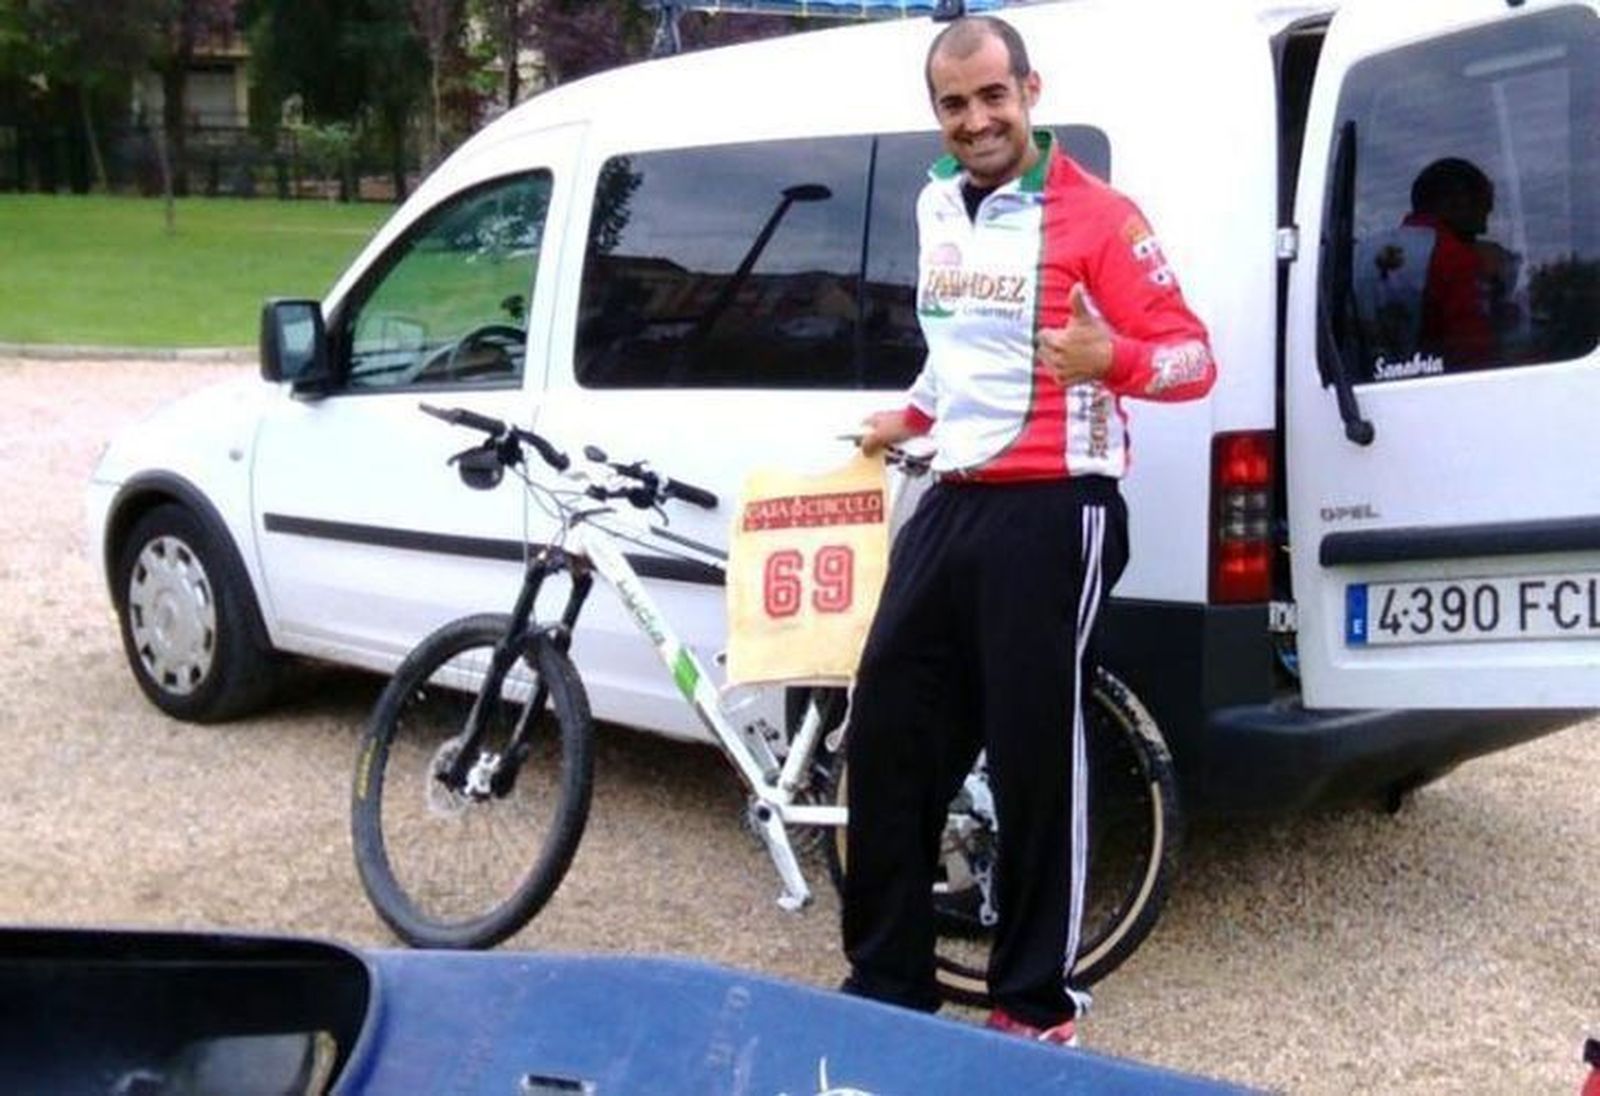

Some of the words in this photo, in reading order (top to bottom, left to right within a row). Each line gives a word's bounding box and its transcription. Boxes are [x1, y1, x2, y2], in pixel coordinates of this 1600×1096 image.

[1373, 352, 1443, 380] Sanabria
[1320, 504, 1379, 522] OPEL
[764, 545, 854, 619] 69
[1379, 585, 1499, 635] 4390
